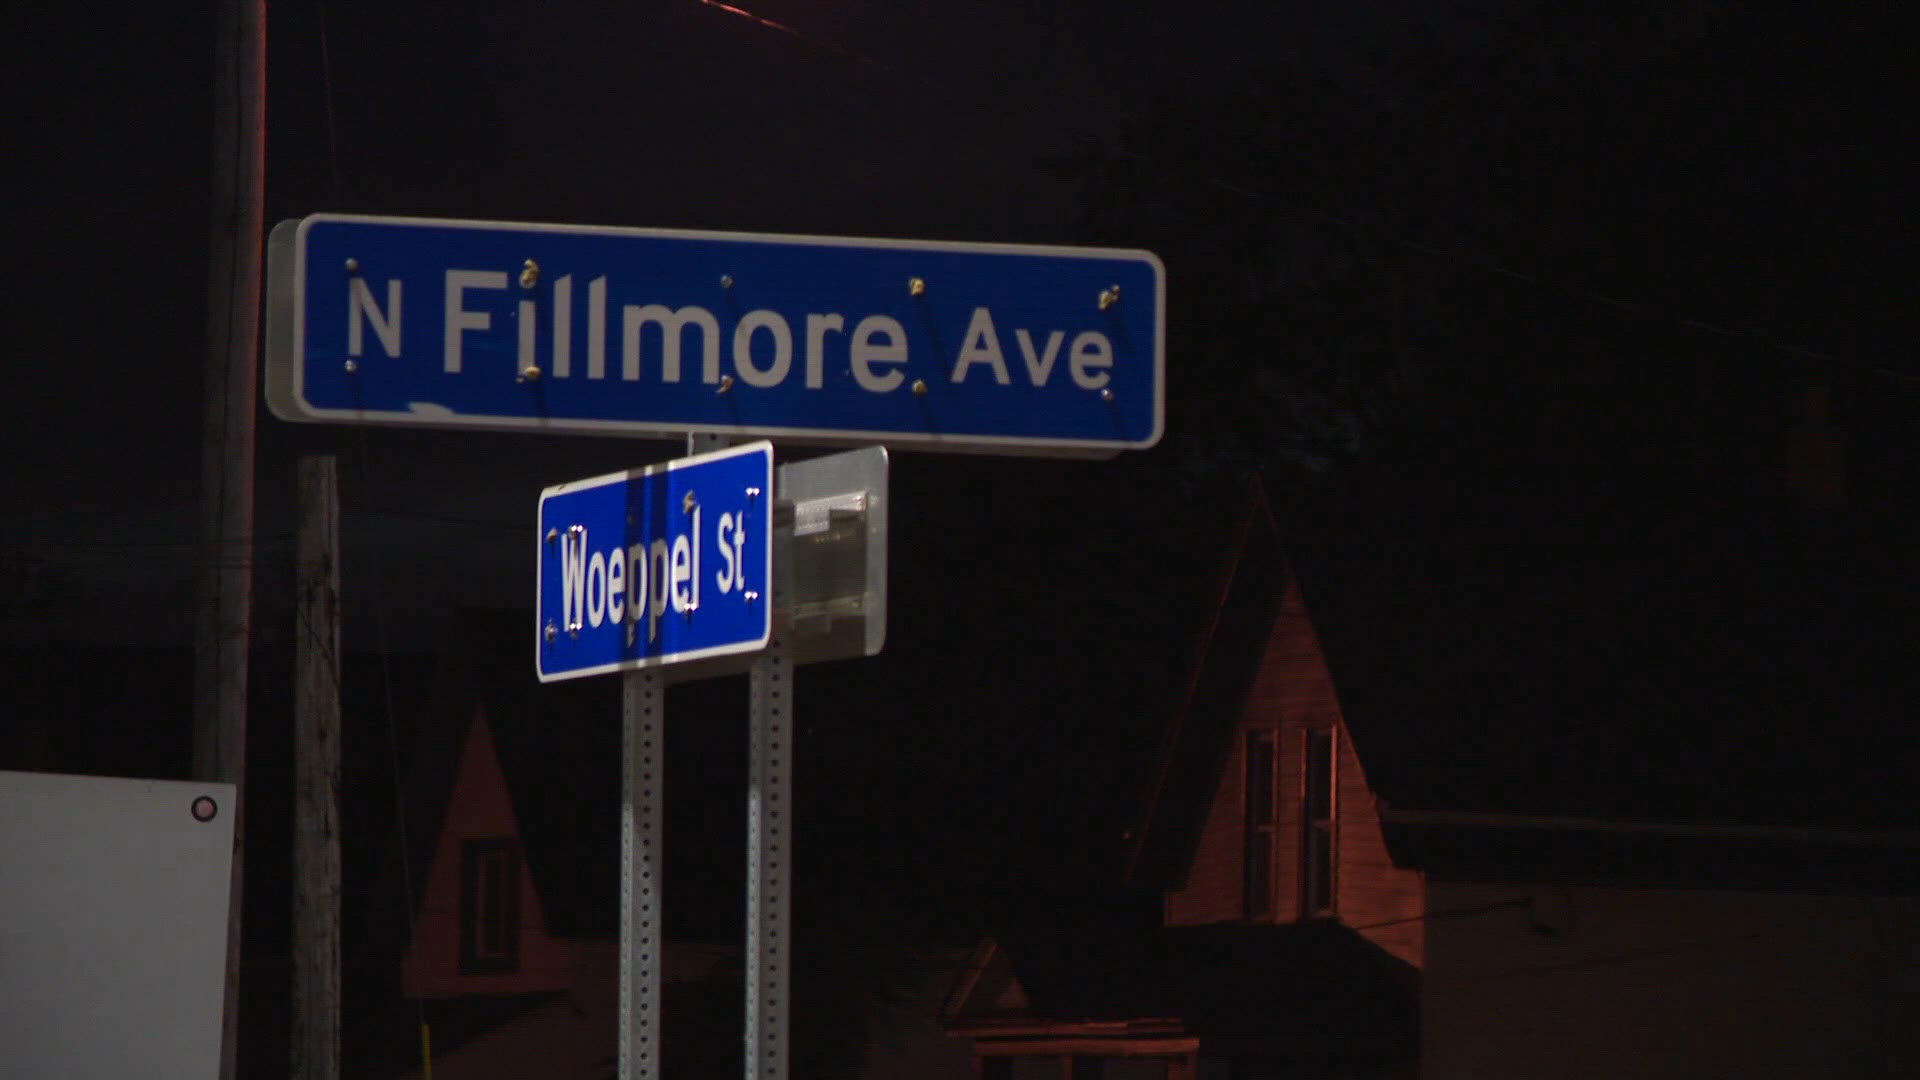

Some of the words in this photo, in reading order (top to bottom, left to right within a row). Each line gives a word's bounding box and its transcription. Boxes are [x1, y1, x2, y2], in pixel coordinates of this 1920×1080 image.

[348, 277, 402, 358] N
[443, 268, 908, 394] Fillmore
[950, 306, 1114, 390] Ave
[560, 505, 701, 648] Woeppel
[716, 510, 747, 594] St
